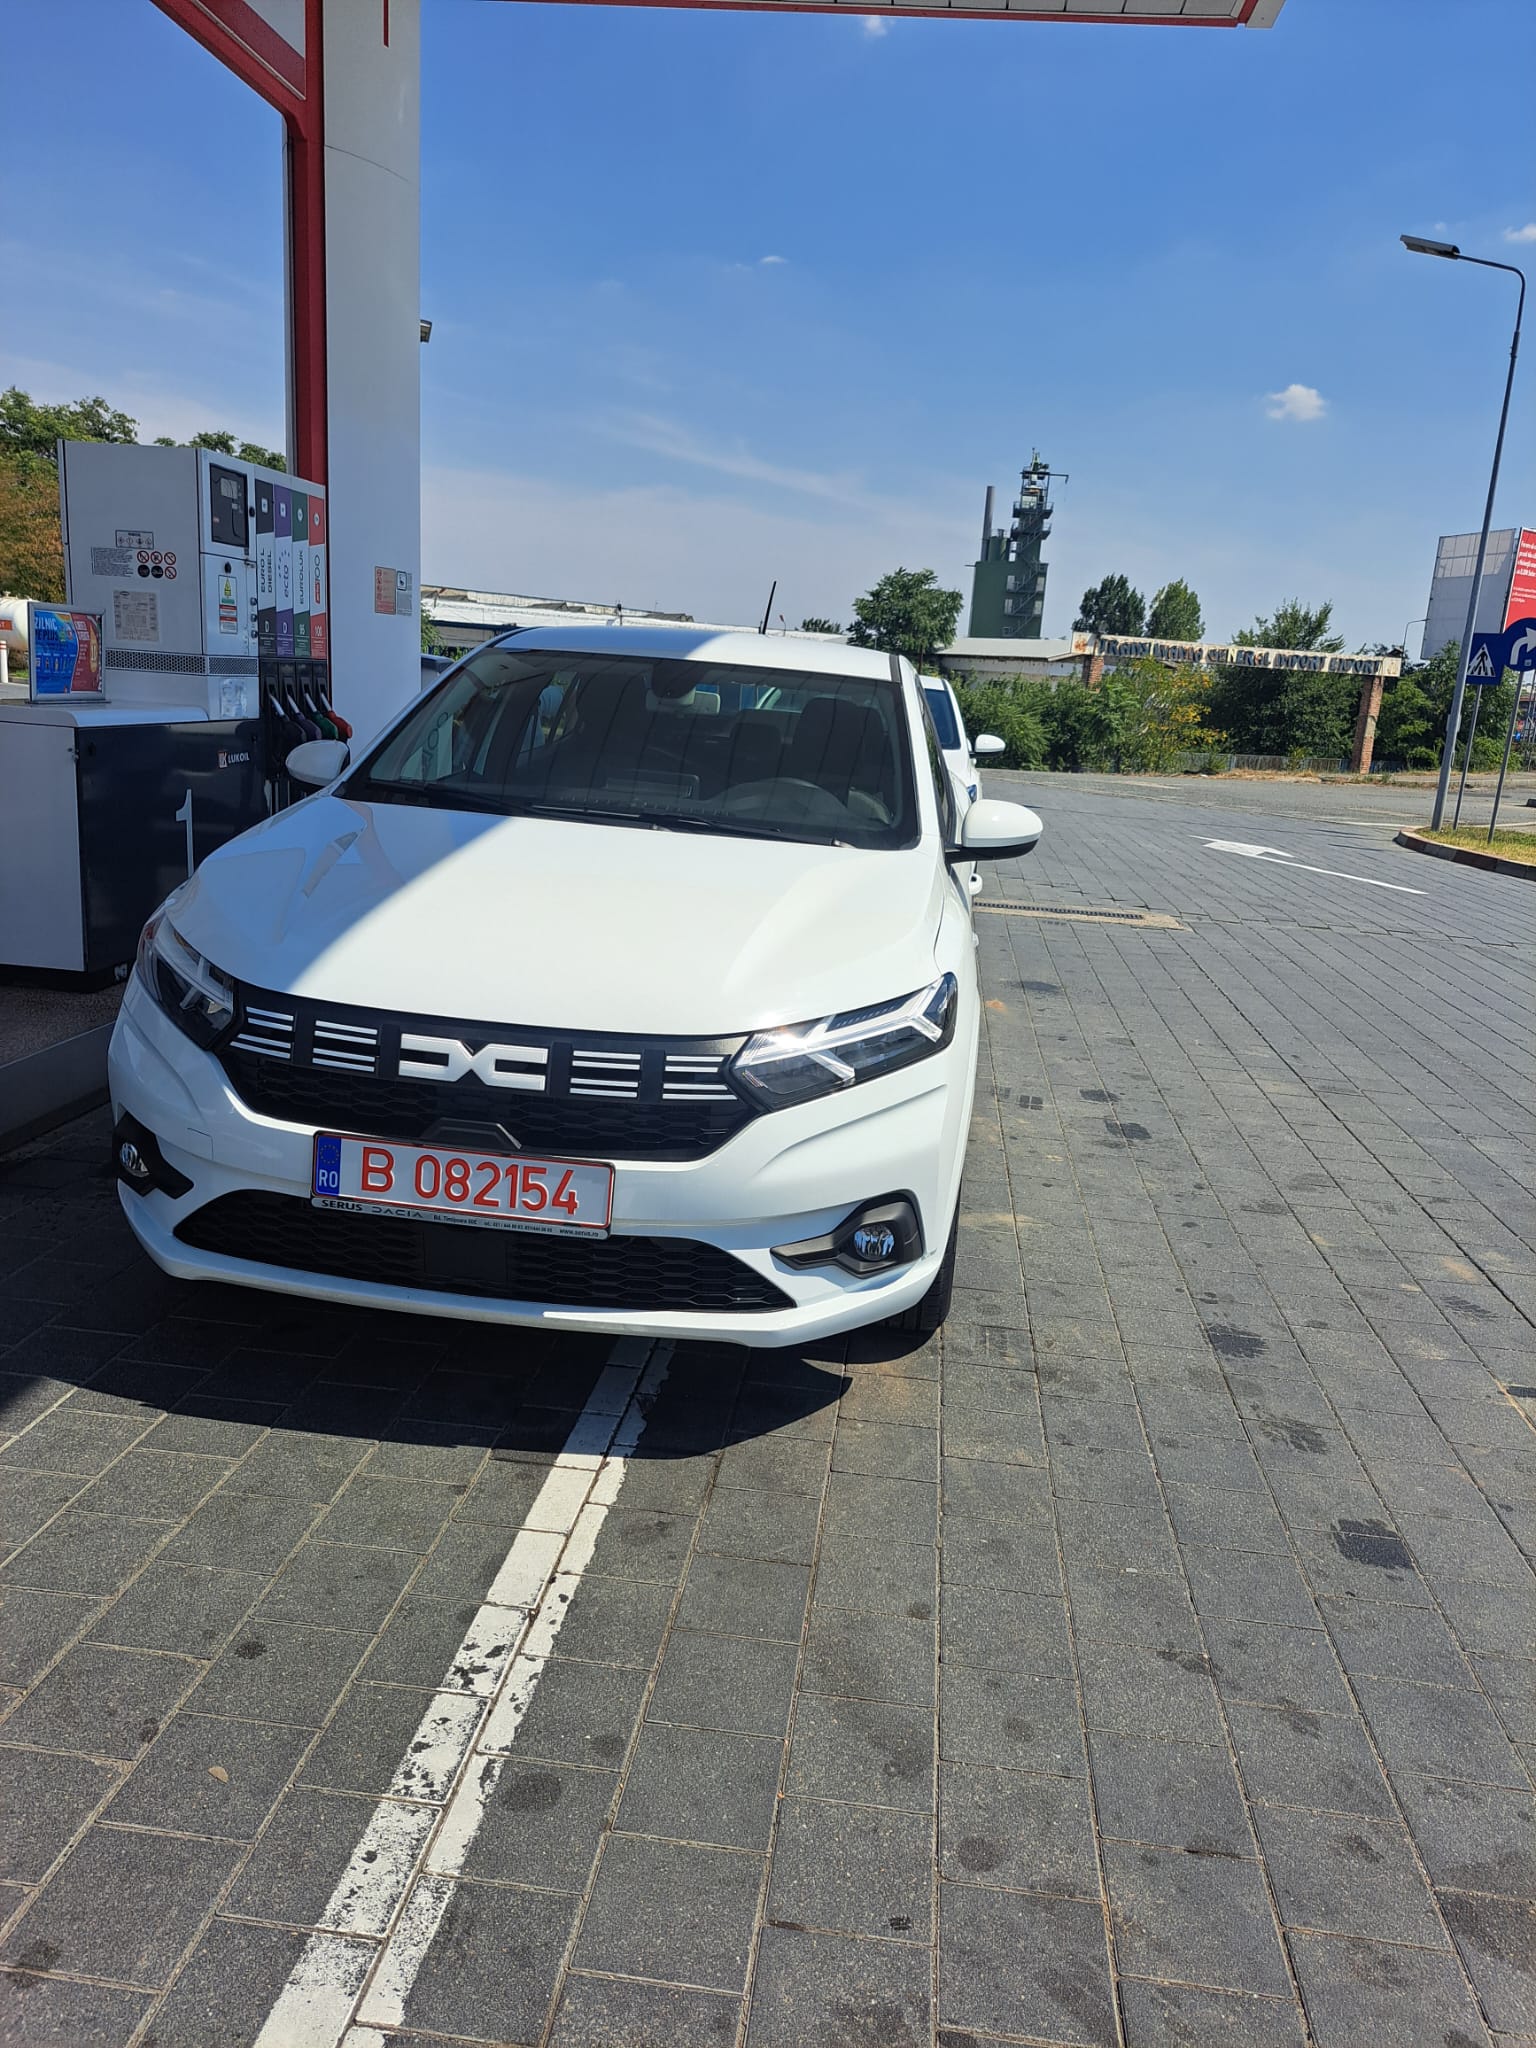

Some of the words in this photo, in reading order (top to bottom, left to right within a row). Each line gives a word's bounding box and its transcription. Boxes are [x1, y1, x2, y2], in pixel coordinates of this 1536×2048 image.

[1273, 652, 1328, 671] IMPORT
[227, 751, 250, 764] LUKOIL
[175, 788, 195, 880] 1
[319, 1169, 338, 1188] RO
[361, 1146, 395, 1193] B
[414, 1154, 578, 1215] 082154
[321, 1199, 363, 1212] SERUS
[371, 1206, 425, 1219] DACIA
